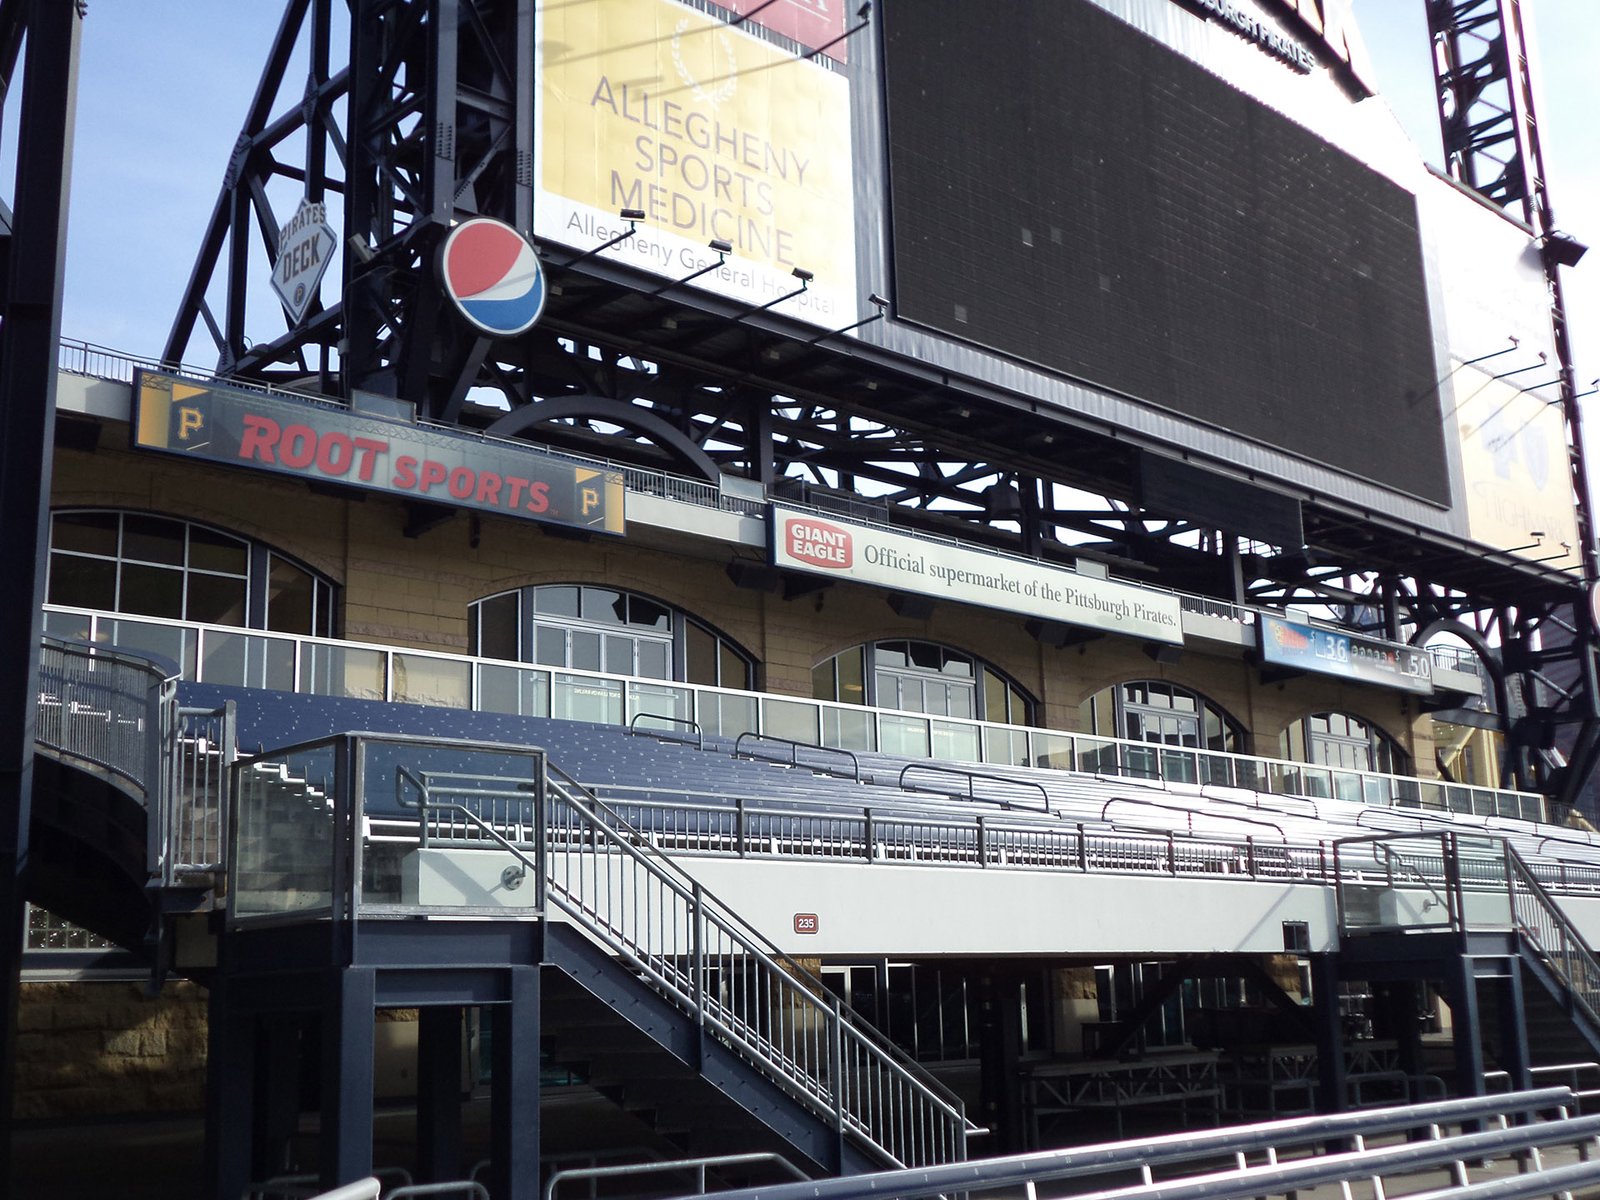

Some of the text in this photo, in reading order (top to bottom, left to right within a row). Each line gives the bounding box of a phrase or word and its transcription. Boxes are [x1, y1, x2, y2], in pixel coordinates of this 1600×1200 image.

[1258, 24, 1317, 72] PIRATES
[590, 75, 810, 187] ALLEGHENY
[635, 134, 774, 217] SPORTS
[279, 204, 327, 250] PIRATES
[611, 170, 795, 267] MEDICINE
[282, 233, 320, 285] DECK
[566, 210, 836, 322] Allegheny General Hospital
[178, 406, 205, 440] P
[238, 413, 551, 514] ROOT SPORTS
[582, 487, 600, 516] P
[790, 522, 847, 549] GIANT
[792, 540, 846, 565] EAGLE
[864, 543, 1177, 627] Official supermarket of the Pittsburgh Pirates.
[1326, 636, 1347, 660] 36
[1410, 655, 1430, 677] 50
[798, 918, 815, 929] 235
